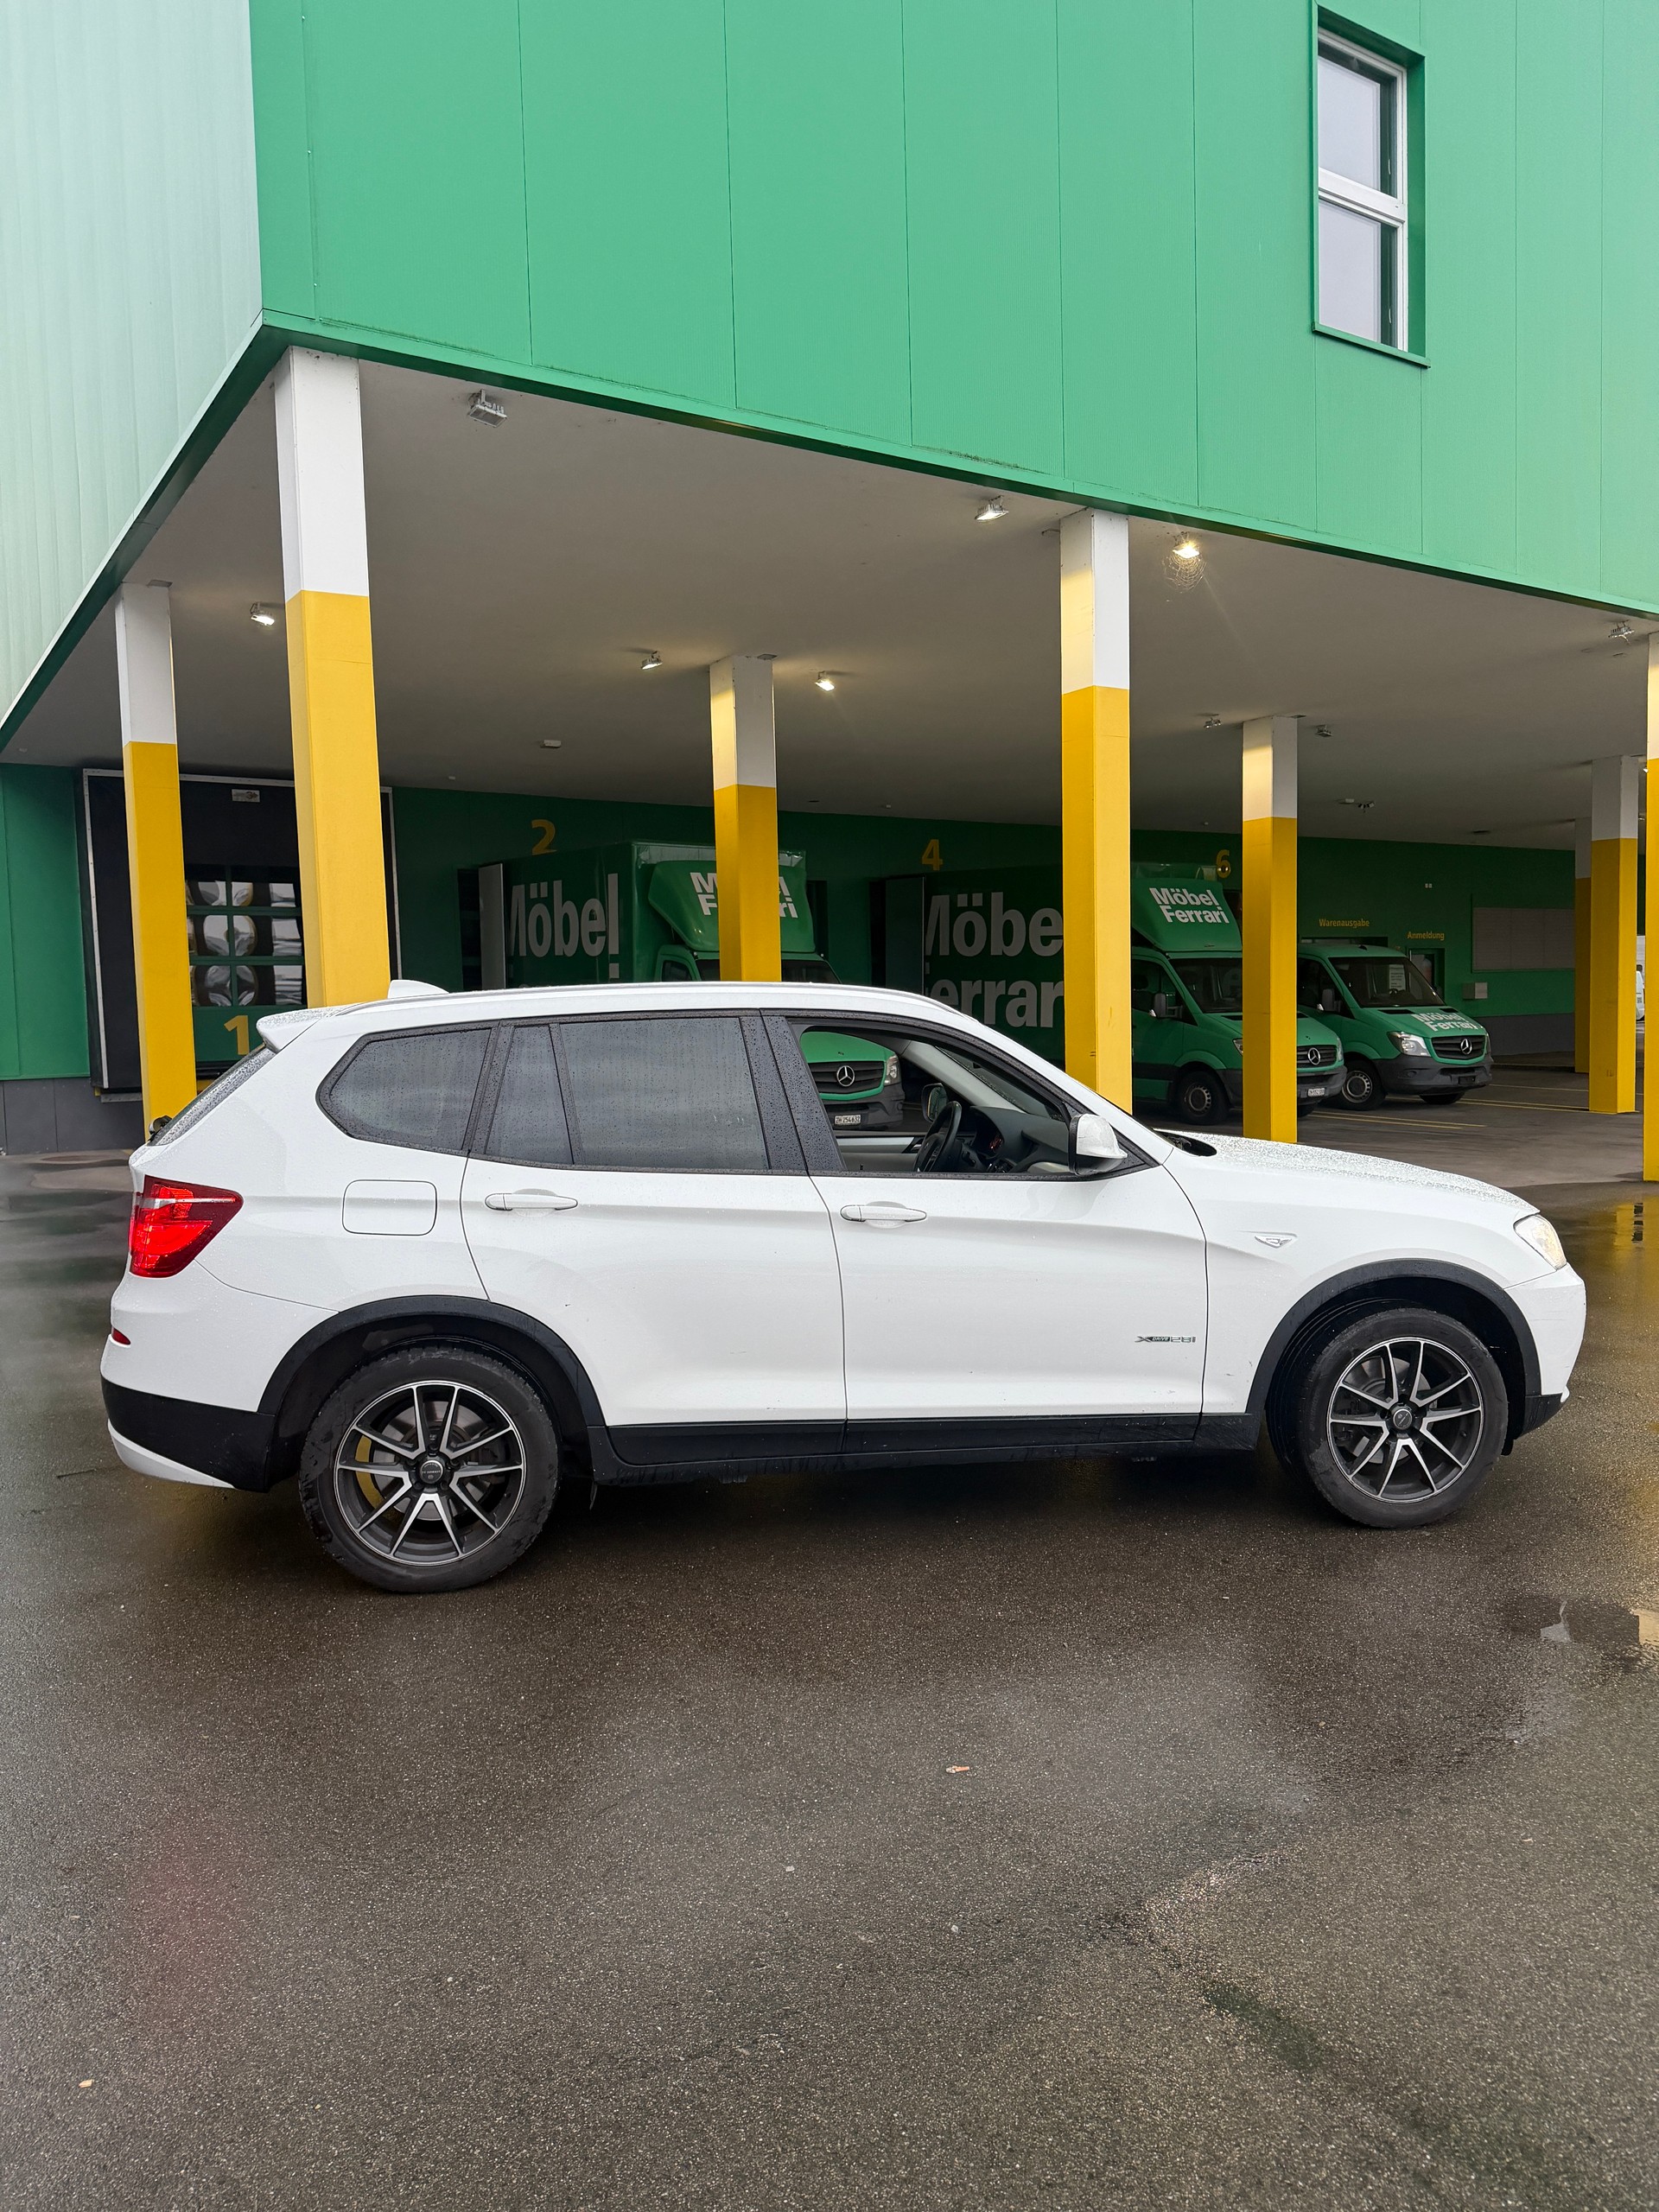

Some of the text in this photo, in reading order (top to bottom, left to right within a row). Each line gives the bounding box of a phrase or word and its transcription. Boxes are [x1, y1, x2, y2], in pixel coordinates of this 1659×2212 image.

[531, 819, 556, 855] 2
[921, 839, 943, 871] 4
[1217, 849, 1230, 878] 6
[1149, 887, 1219, 906] Möbel
[925, 892, 1064, 957] Möbe
[1159, 905, 1230, 924] Ferrari
[1319, 918, 1370, 929] Warenausgabe
[1407, 931, 1445, 941] Anmeldung
[925, 962, 1065, 1028] errar
[1410, 1012, 1467, 1023] Möbel
[1424, 1020, 1478, 1032] Ferrari
[224, 1014, 250, 1055] 1
